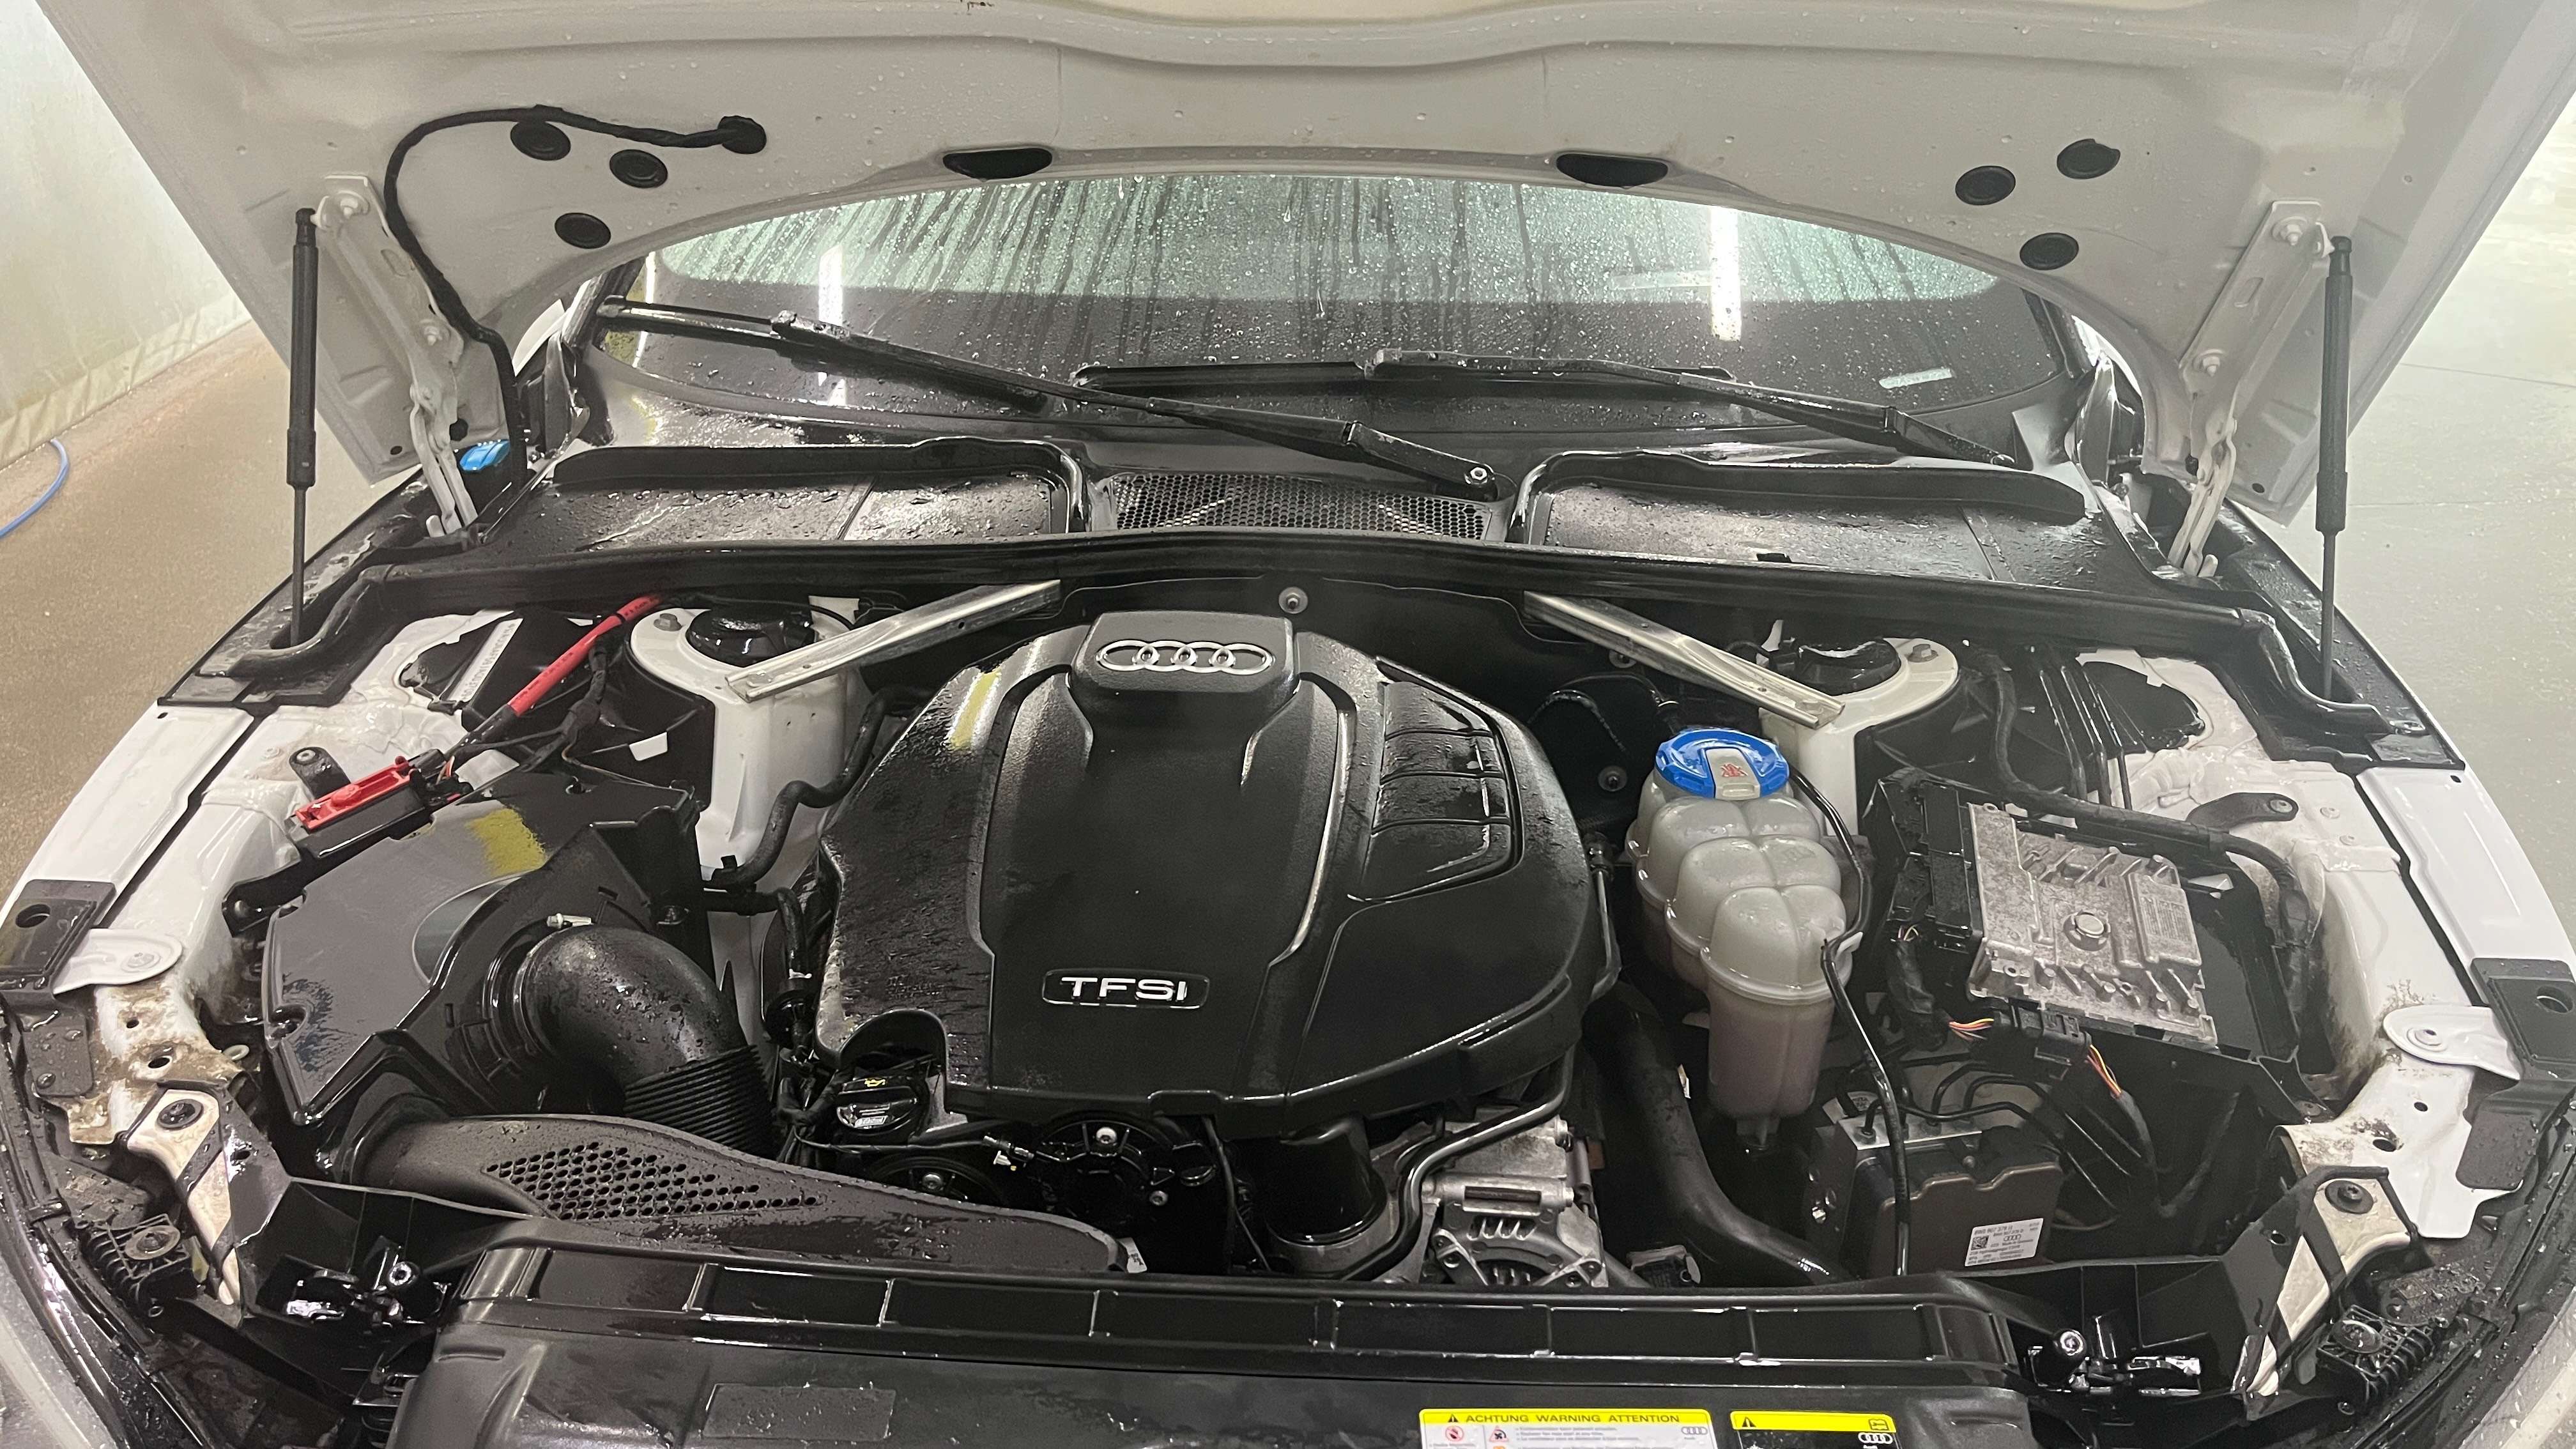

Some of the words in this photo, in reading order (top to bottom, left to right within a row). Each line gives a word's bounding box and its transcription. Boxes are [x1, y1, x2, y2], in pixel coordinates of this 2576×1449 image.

[1060, 976, 1188, 1001] TFSI
[1466, 1414, 1529, 1423] ACHTUNG
[1535, 1414, 1601, 1423] WARNING
[1608, 1414, 1680, 1423] ATTENTION
